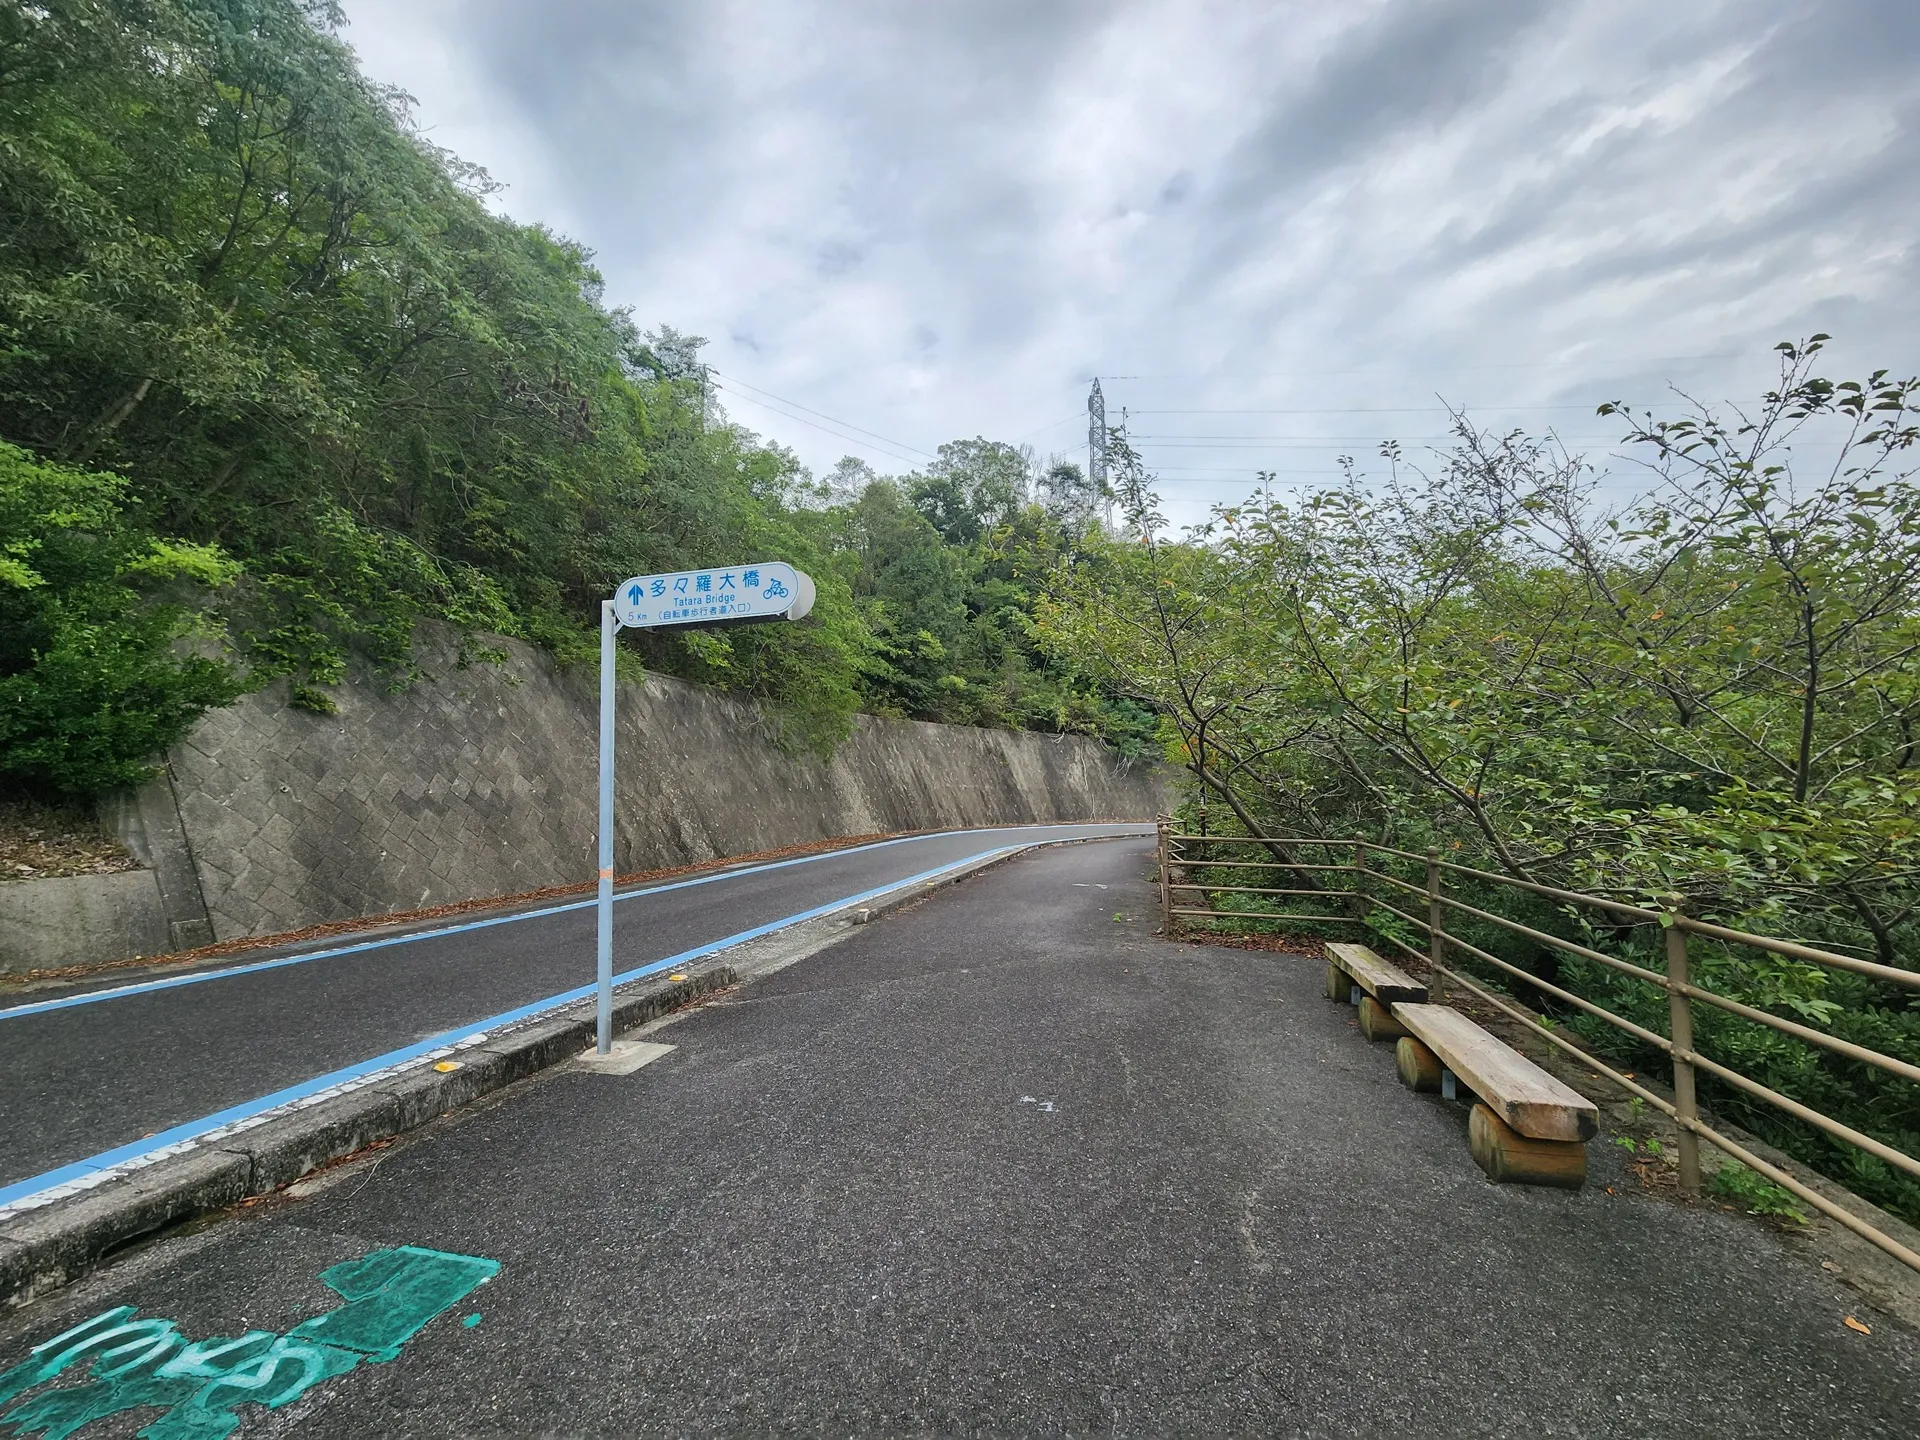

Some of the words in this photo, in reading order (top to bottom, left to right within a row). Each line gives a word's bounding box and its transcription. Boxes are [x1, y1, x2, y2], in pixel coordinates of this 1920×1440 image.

[650, 569, 760, 598] 多々羅大橋
[673, 596, 702, 607] Tatara
[705, 593, 736, 604] Bridge
[627, 611, 635, 622] 5
